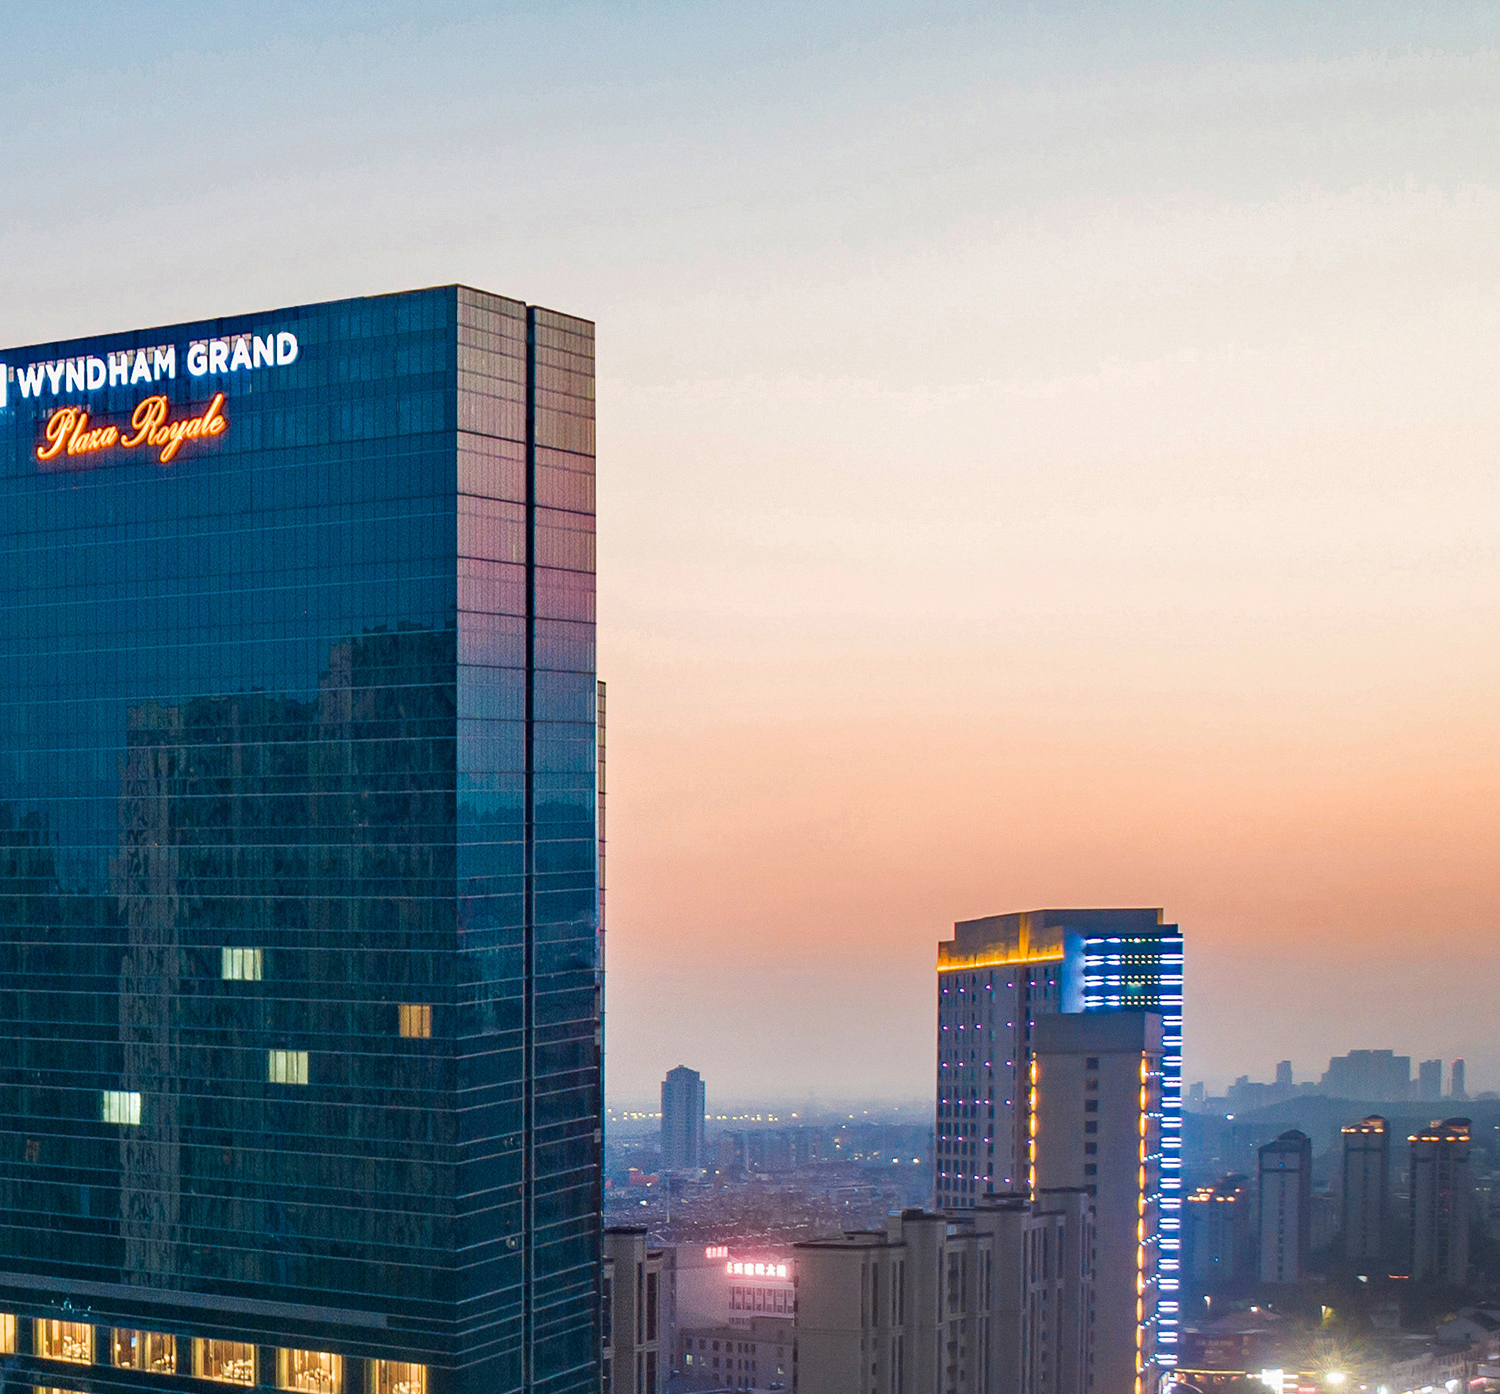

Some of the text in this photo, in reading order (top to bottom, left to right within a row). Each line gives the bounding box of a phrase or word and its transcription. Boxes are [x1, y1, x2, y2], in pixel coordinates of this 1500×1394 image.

[16, 331, 299, 398] WYNDHAM GRAND
[37, 393, 226, 463] Plaza Royale
